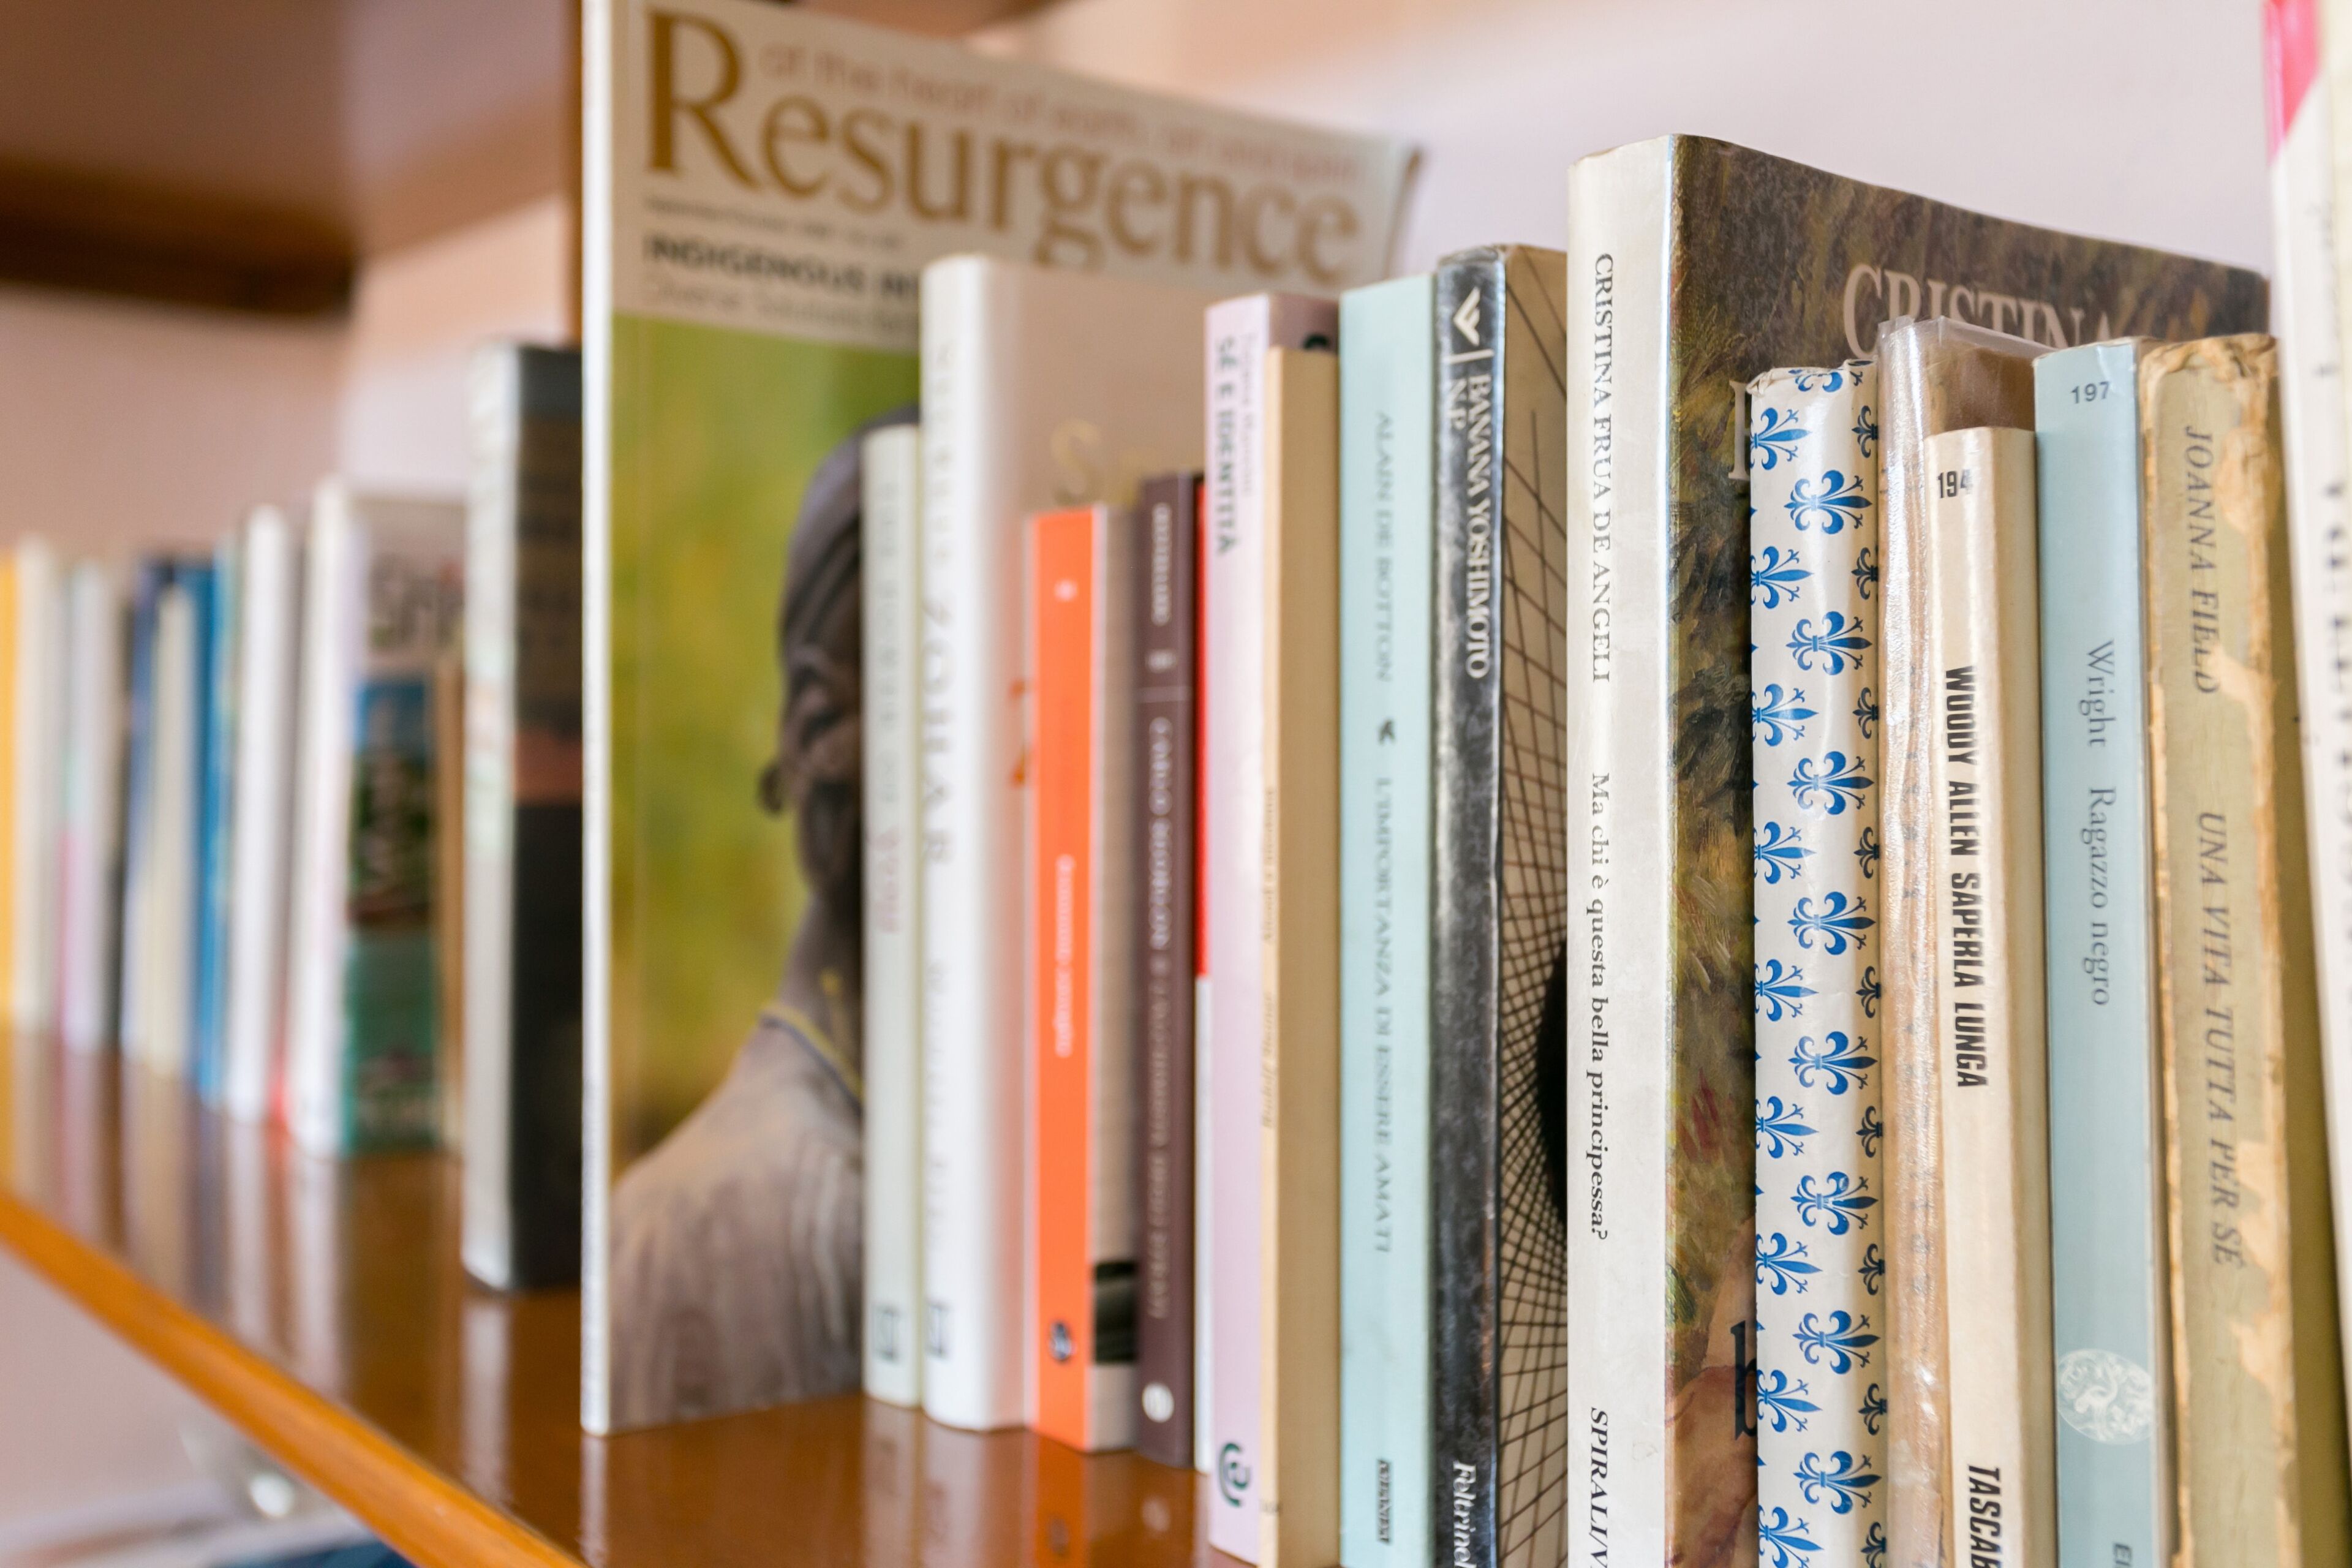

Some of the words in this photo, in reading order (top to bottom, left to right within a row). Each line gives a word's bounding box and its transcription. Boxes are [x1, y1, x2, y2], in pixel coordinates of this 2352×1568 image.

[644, 9, 1363, 288] Resurgence
[1594, 253, 1613, 408] CRISTINA
[1467, 374, 1491, 497] BANANA
[2070, 380, 2110, 404] 197
[1594, 414, 1611, 500] FRUA
[2184, 426, 2218, 573] JOANNA
[1593, 508, 1611, 553] DE
[1466, 498, 1490, 678] YOSHIMOTO
[1593, 560, 1610, 683] ANGELI
[2192, 589, 2220, 695] FIELD
[1946, 665, 1980, 766] WOODY
[2078, 638, 2117, 747] Wright
[1593, 772, 1609, 816] Ma
[1949, 780, 1981, 856] ALLEN
[1592, 825, 1609, 866] chi
[1592, 874, 1609, 890] è
[2080, 787, 2117, 910] Ragazzo
[2198, 812, 2230, 885] UNA
[1586, 899, 1605, 988] questa
[1951, 873, 1986, 988] SAPERLA
[2081, 921, 2109, 1006] negro
[2203, 907, 2233, 986] VITA
[1592, 997, 1608, 1063] bella
[1955, 1002, 1989, 1087] LUNGA
[2205, 1008, 2237, 1121] TUTTA
[1375, 1154, 1393, 1253] AMATI
[1586, 1070, 1608, 1239] principessa?
[2211, 1139, 2241, 1210] PER
[1969, 1464, 2001, 1568] TASCAB
